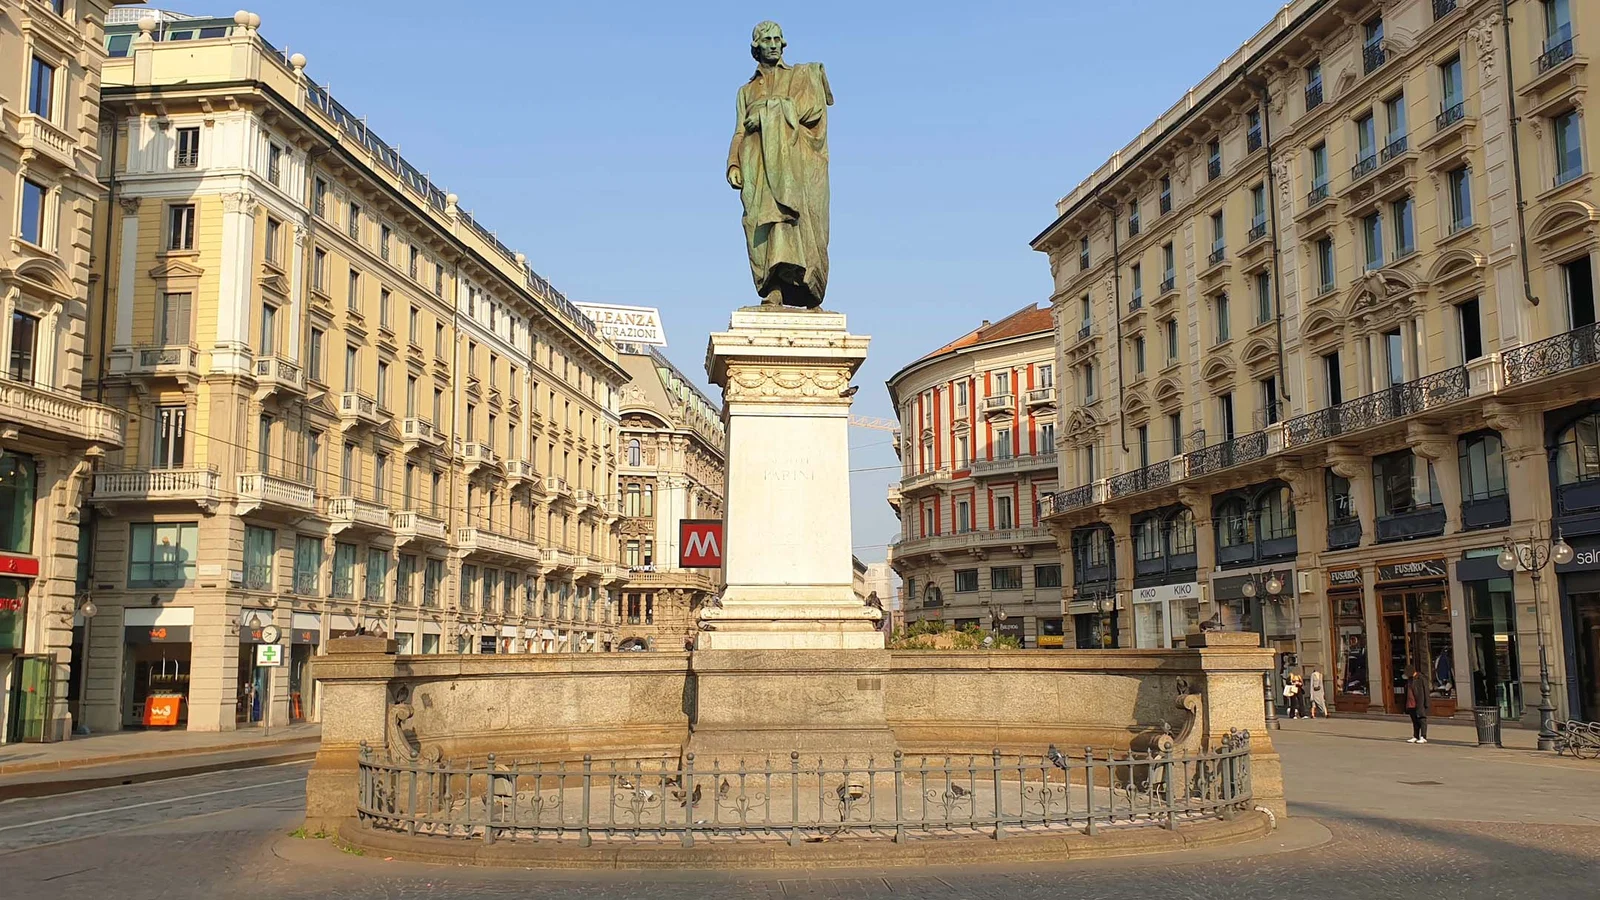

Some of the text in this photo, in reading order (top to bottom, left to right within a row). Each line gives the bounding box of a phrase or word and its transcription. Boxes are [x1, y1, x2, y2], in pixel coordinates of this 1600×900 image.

[586, 310, 656, 327] LLEANZA
[602, 326, 656, 339] URAZIONI
[684, 531, 720, 557] M
[630, 561, 656, 571] work
[1395, 562, 1424, 574] FUSARO
[1140, 588, 1156, 599] KIKO
[1174, 584, 1192, 595] KIKO
